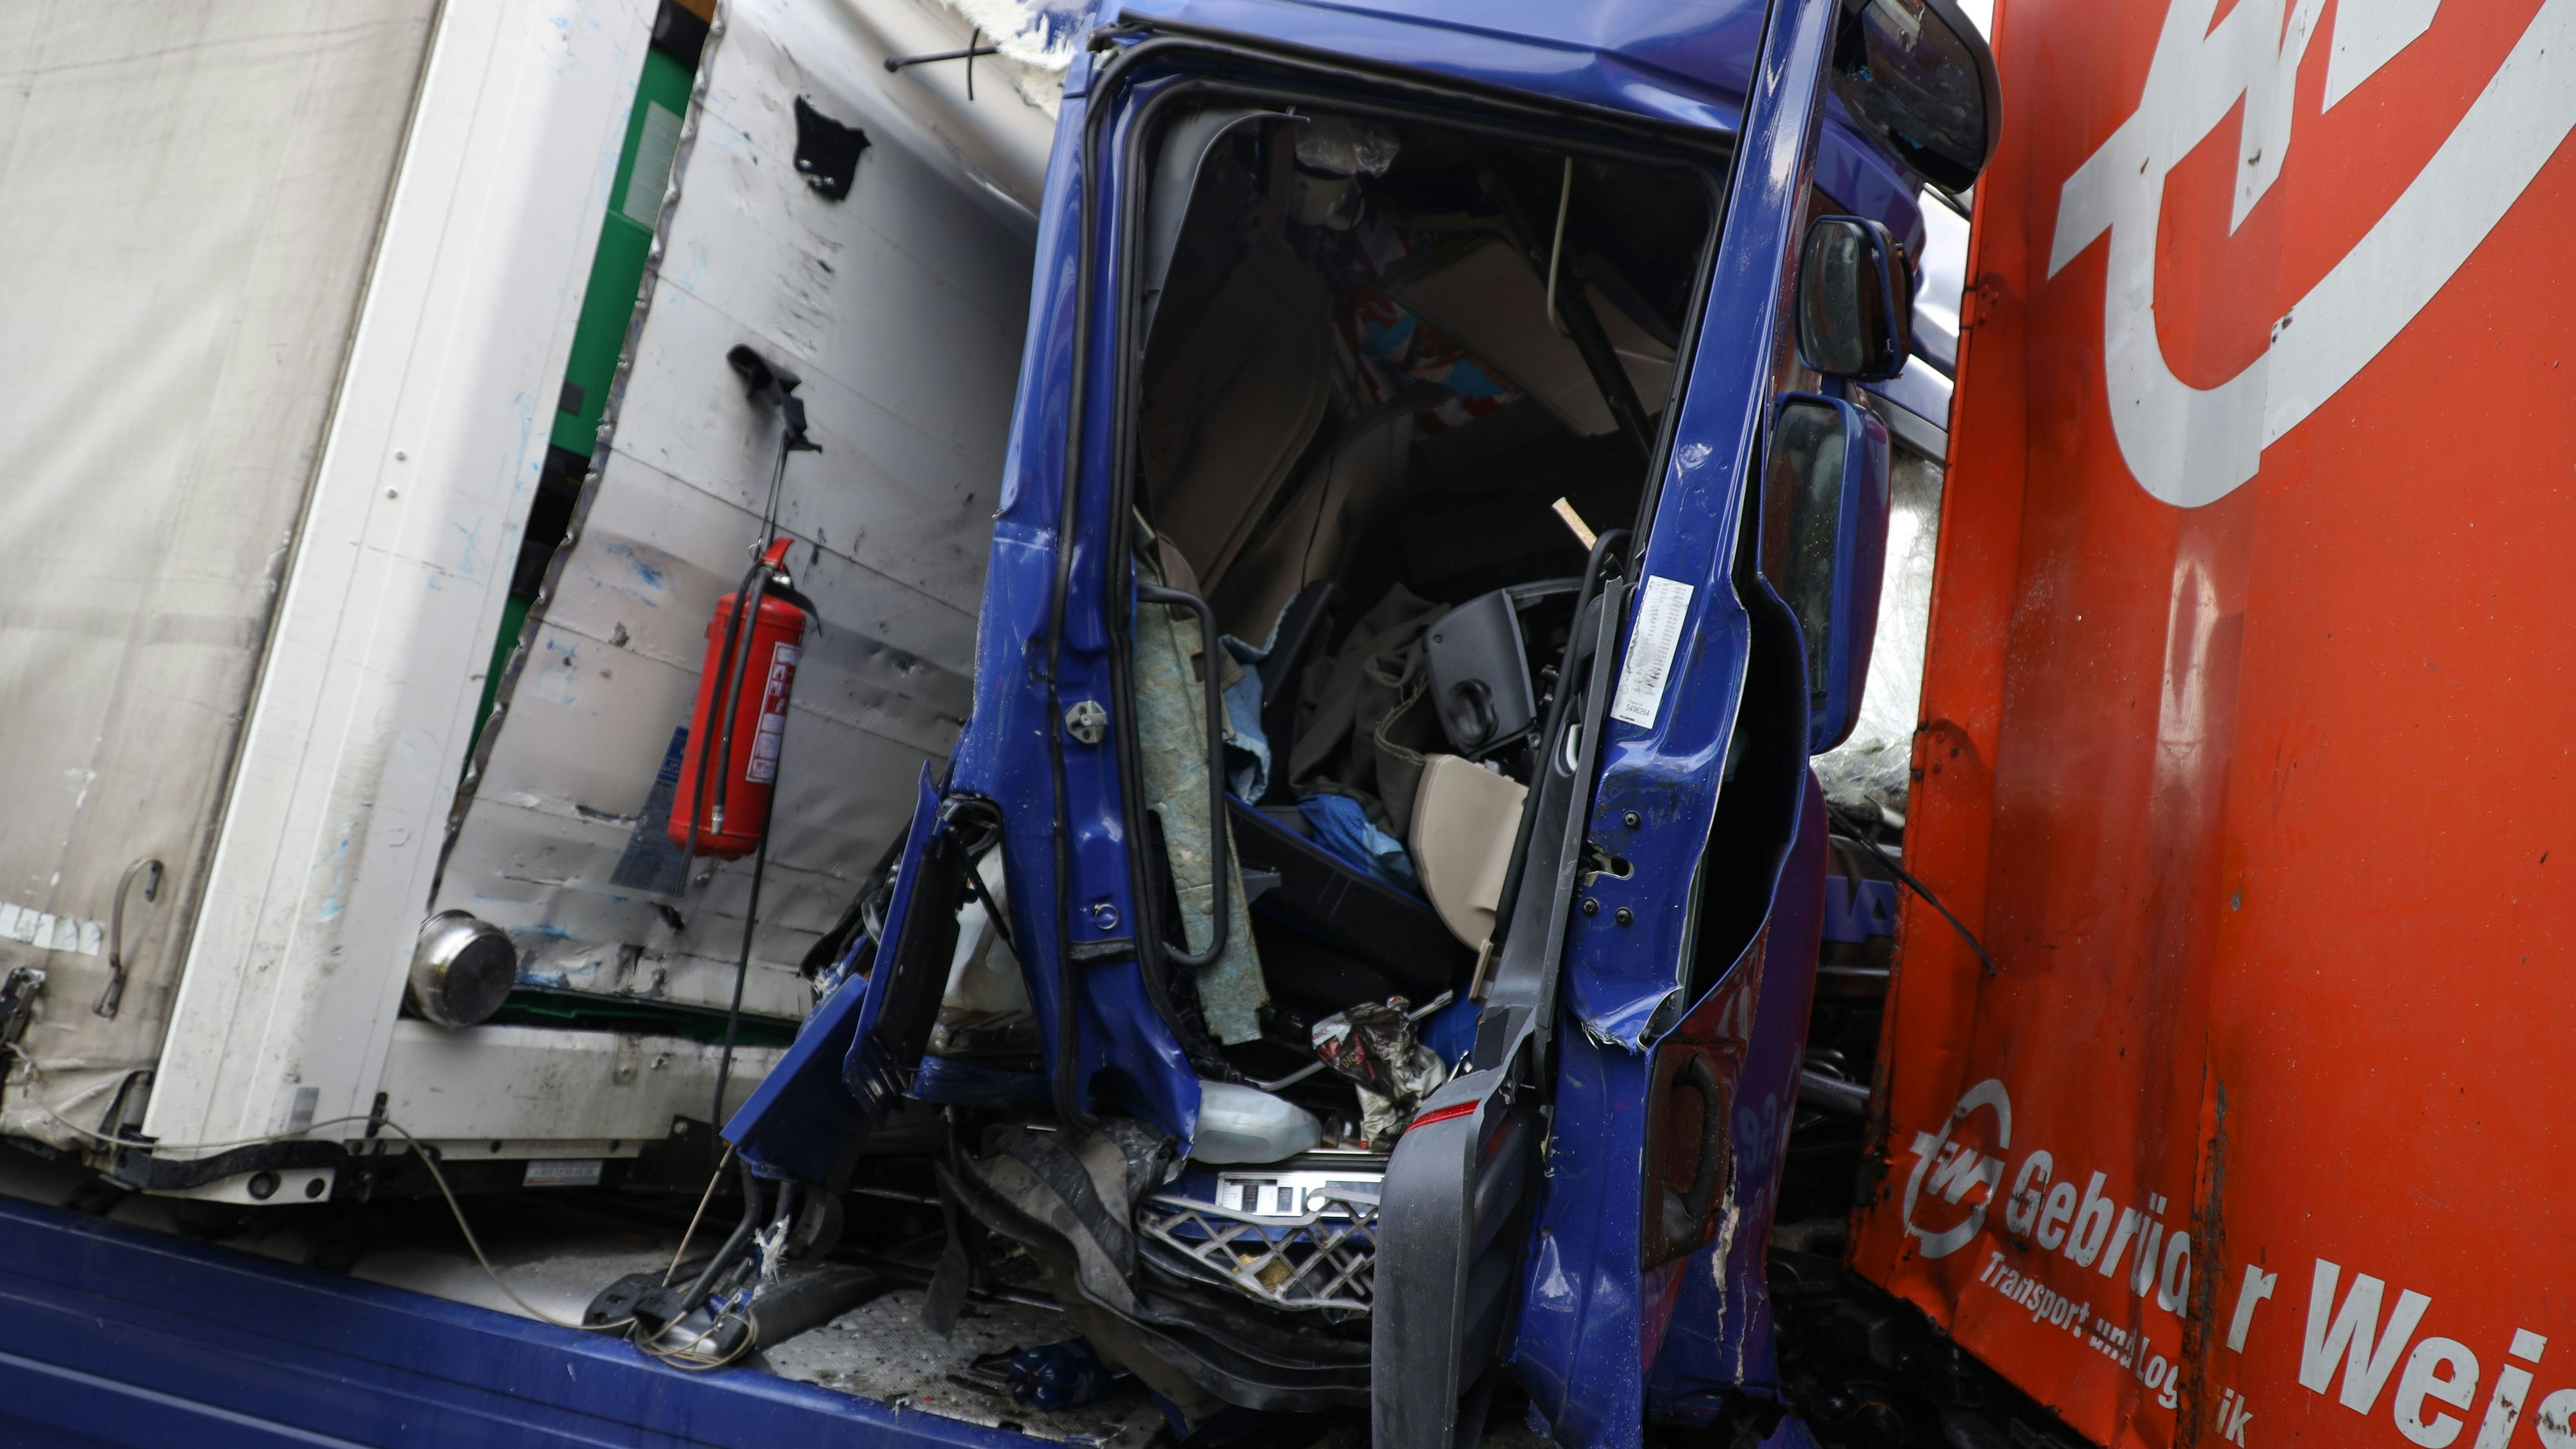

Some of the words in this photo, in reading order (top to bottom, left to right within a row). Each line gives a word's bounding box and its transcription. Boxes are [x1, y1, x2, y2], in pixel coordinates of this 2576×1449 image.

[1980, 1251, 2090, 1338] Transport
[2005, 1150, 2278, 1354] Gebrüdr
[2299, 1258, 2576, 1449] Wei
